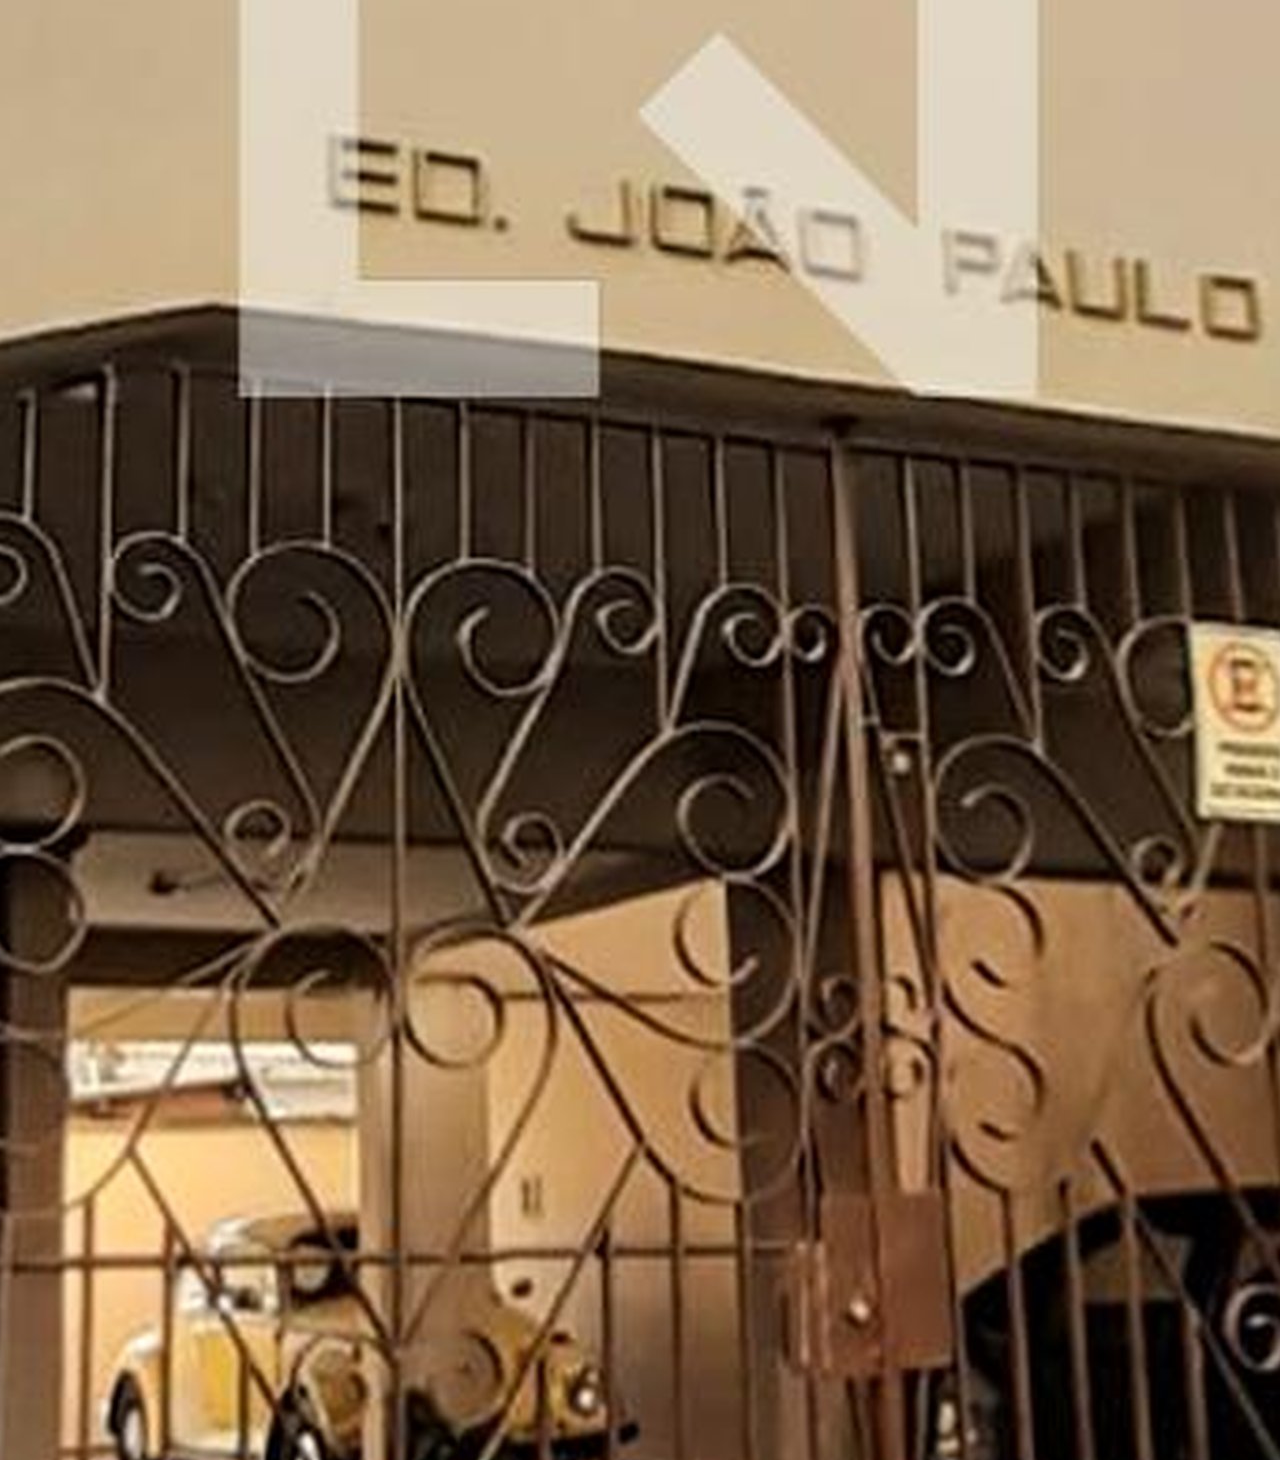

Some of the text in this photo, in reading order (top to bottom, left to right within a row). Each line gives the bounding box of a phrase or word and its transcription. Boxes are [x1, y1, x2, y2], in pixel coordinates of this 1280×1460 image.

[328, 136, 508, 231] ED.
[565, 180, 865, 283] JOÃO
[941, 229, 1261, 343] PAULO
